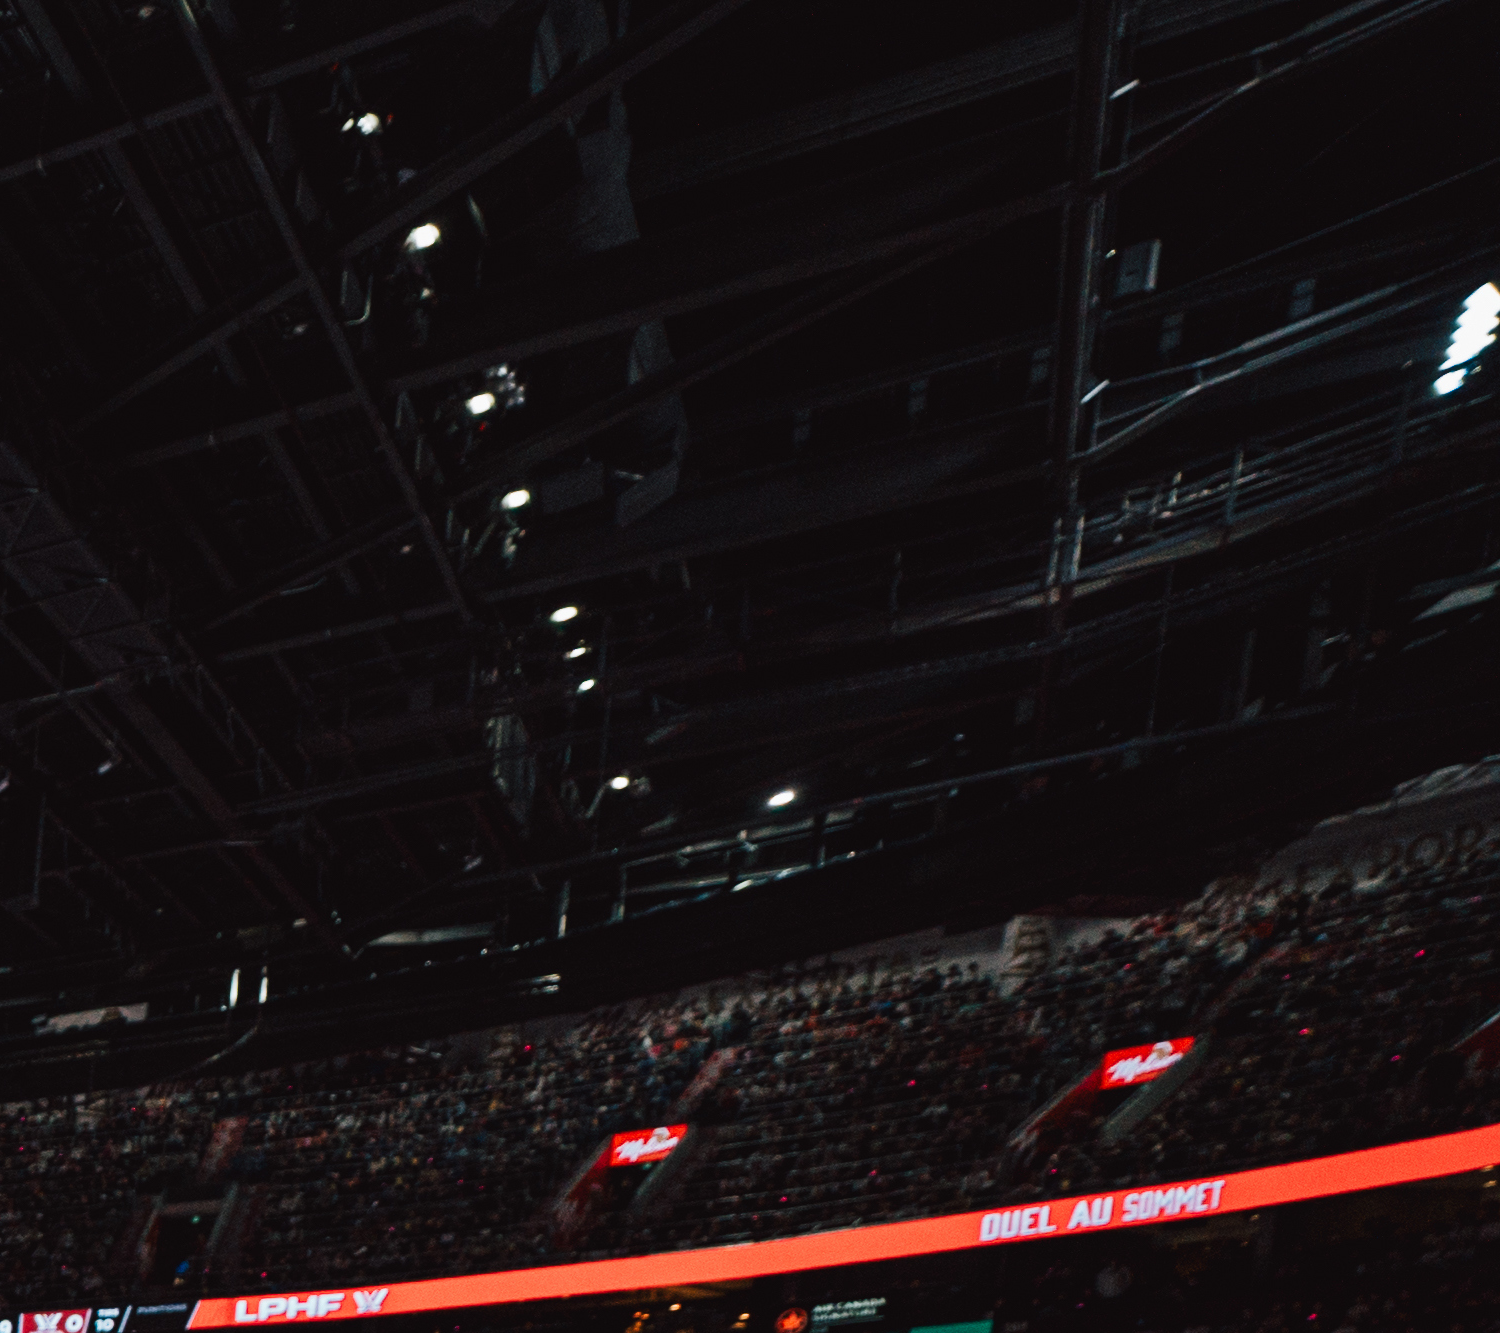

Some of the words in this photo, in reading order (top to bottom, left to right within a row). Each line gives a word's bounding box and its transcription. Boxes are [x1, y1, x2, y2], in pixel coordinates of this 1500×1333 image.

[979, 1205, 1057, 1242] DUEL
[1067, 1197, 1114, 1230] AU
[1121, 1180, 1225, 1223] SOMMET
[234, 1291, 345, 1324] LPHF
